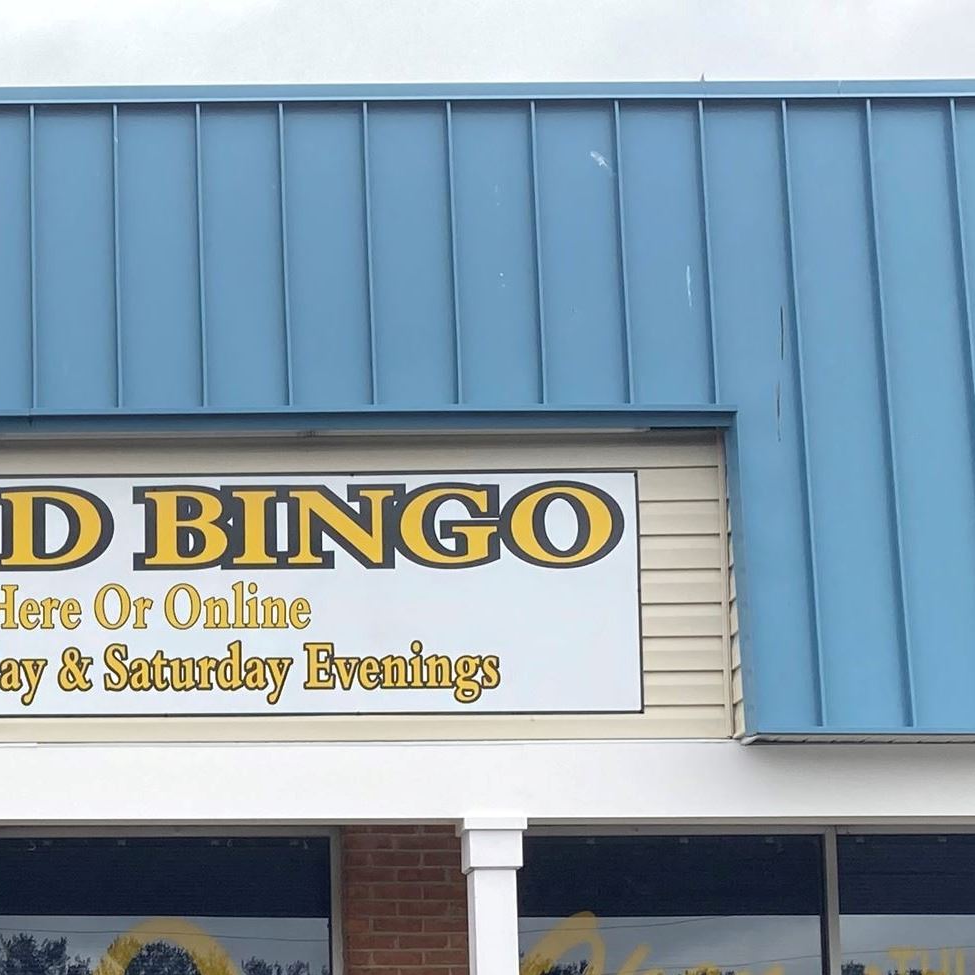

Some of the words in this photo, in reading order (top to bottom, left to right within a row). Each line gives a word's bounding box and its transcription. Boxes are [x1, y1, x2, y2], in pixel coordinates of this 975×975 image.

[132, 480, 625, 571] BINGO
[94, 583, 154, 630] Or
[164, 581, 312, 630] Online
[57, 647, 94, 692] &
[103, 641, 294, 705] Saturday
[303, 641, 502, 704] Evenings
